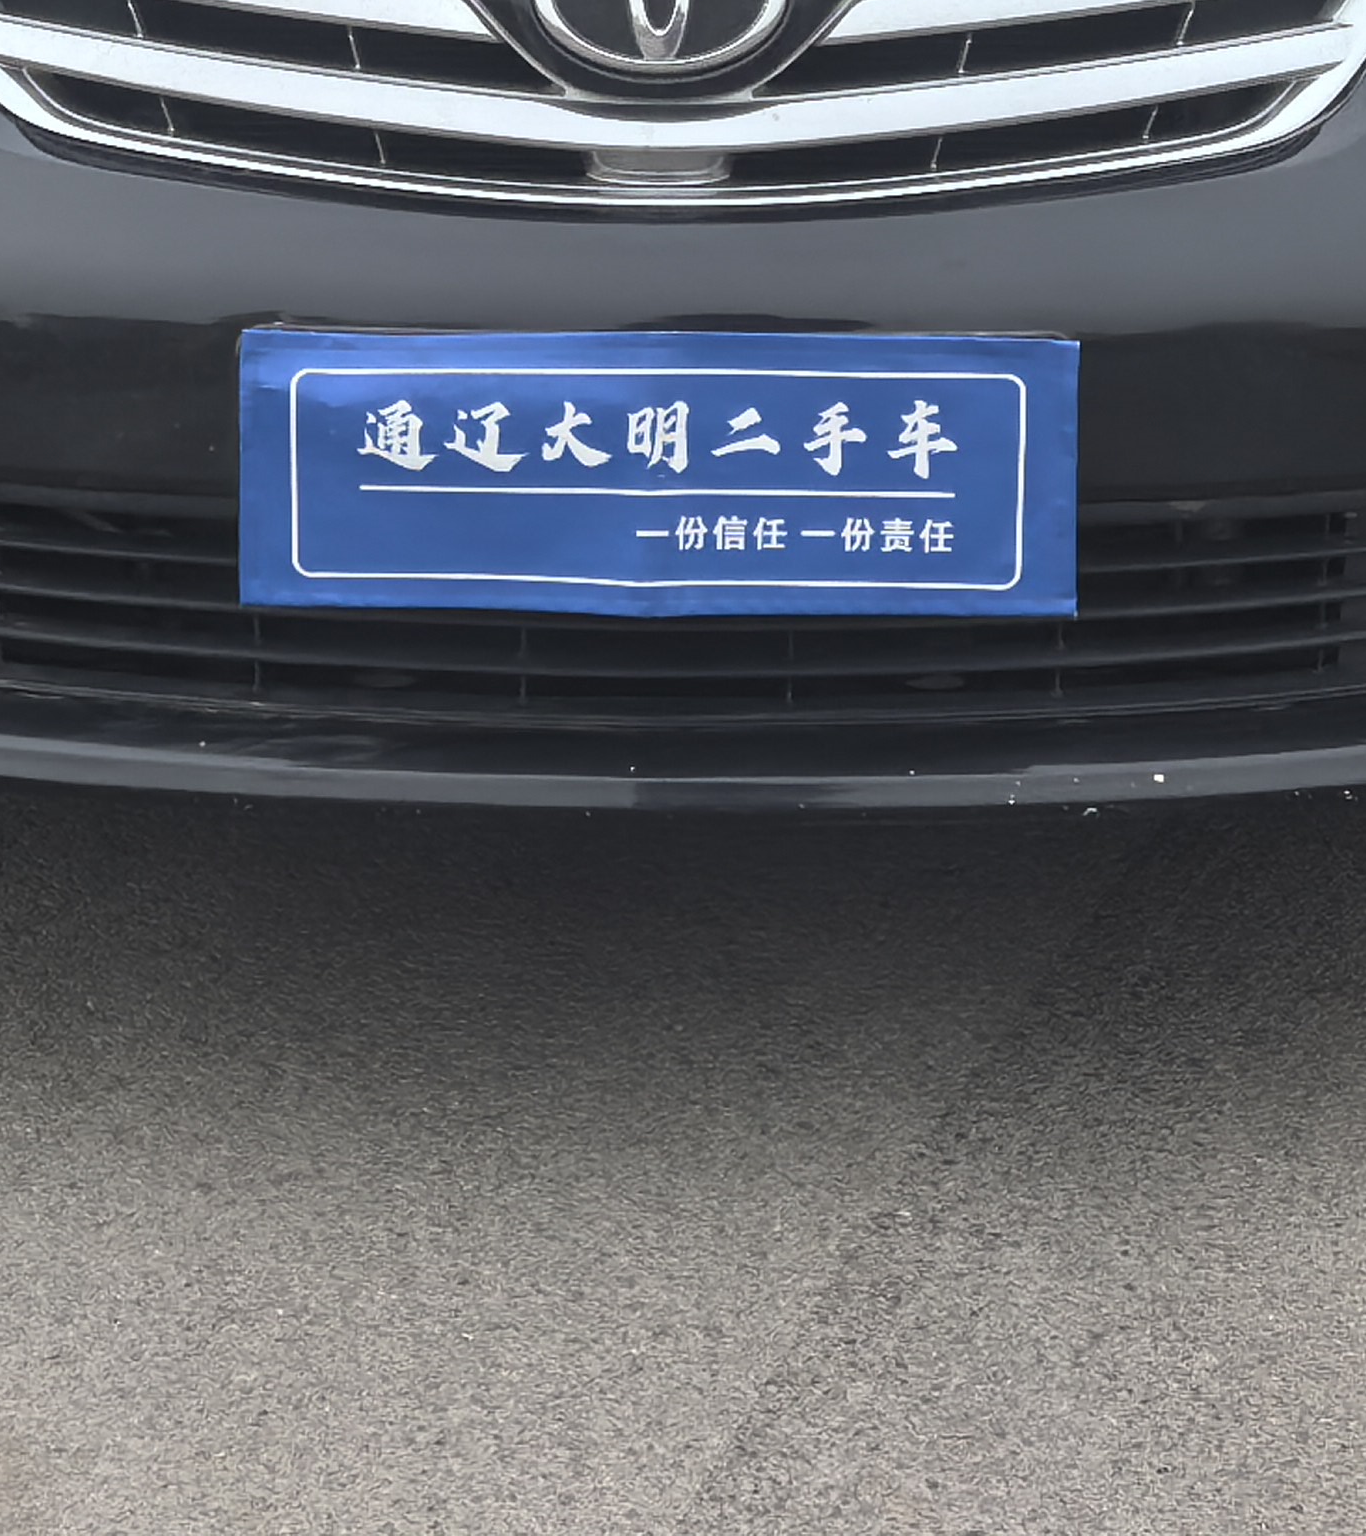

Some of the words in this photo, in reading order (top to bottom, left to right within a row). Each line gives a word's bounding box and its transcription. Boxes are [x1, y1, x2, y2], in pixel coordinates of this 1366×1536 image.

[356, 399, 959, 479] 通辽大明二手车
[635, 515, 789, 552] 一份信任
[800, 517, 955, 555] 一份责任
